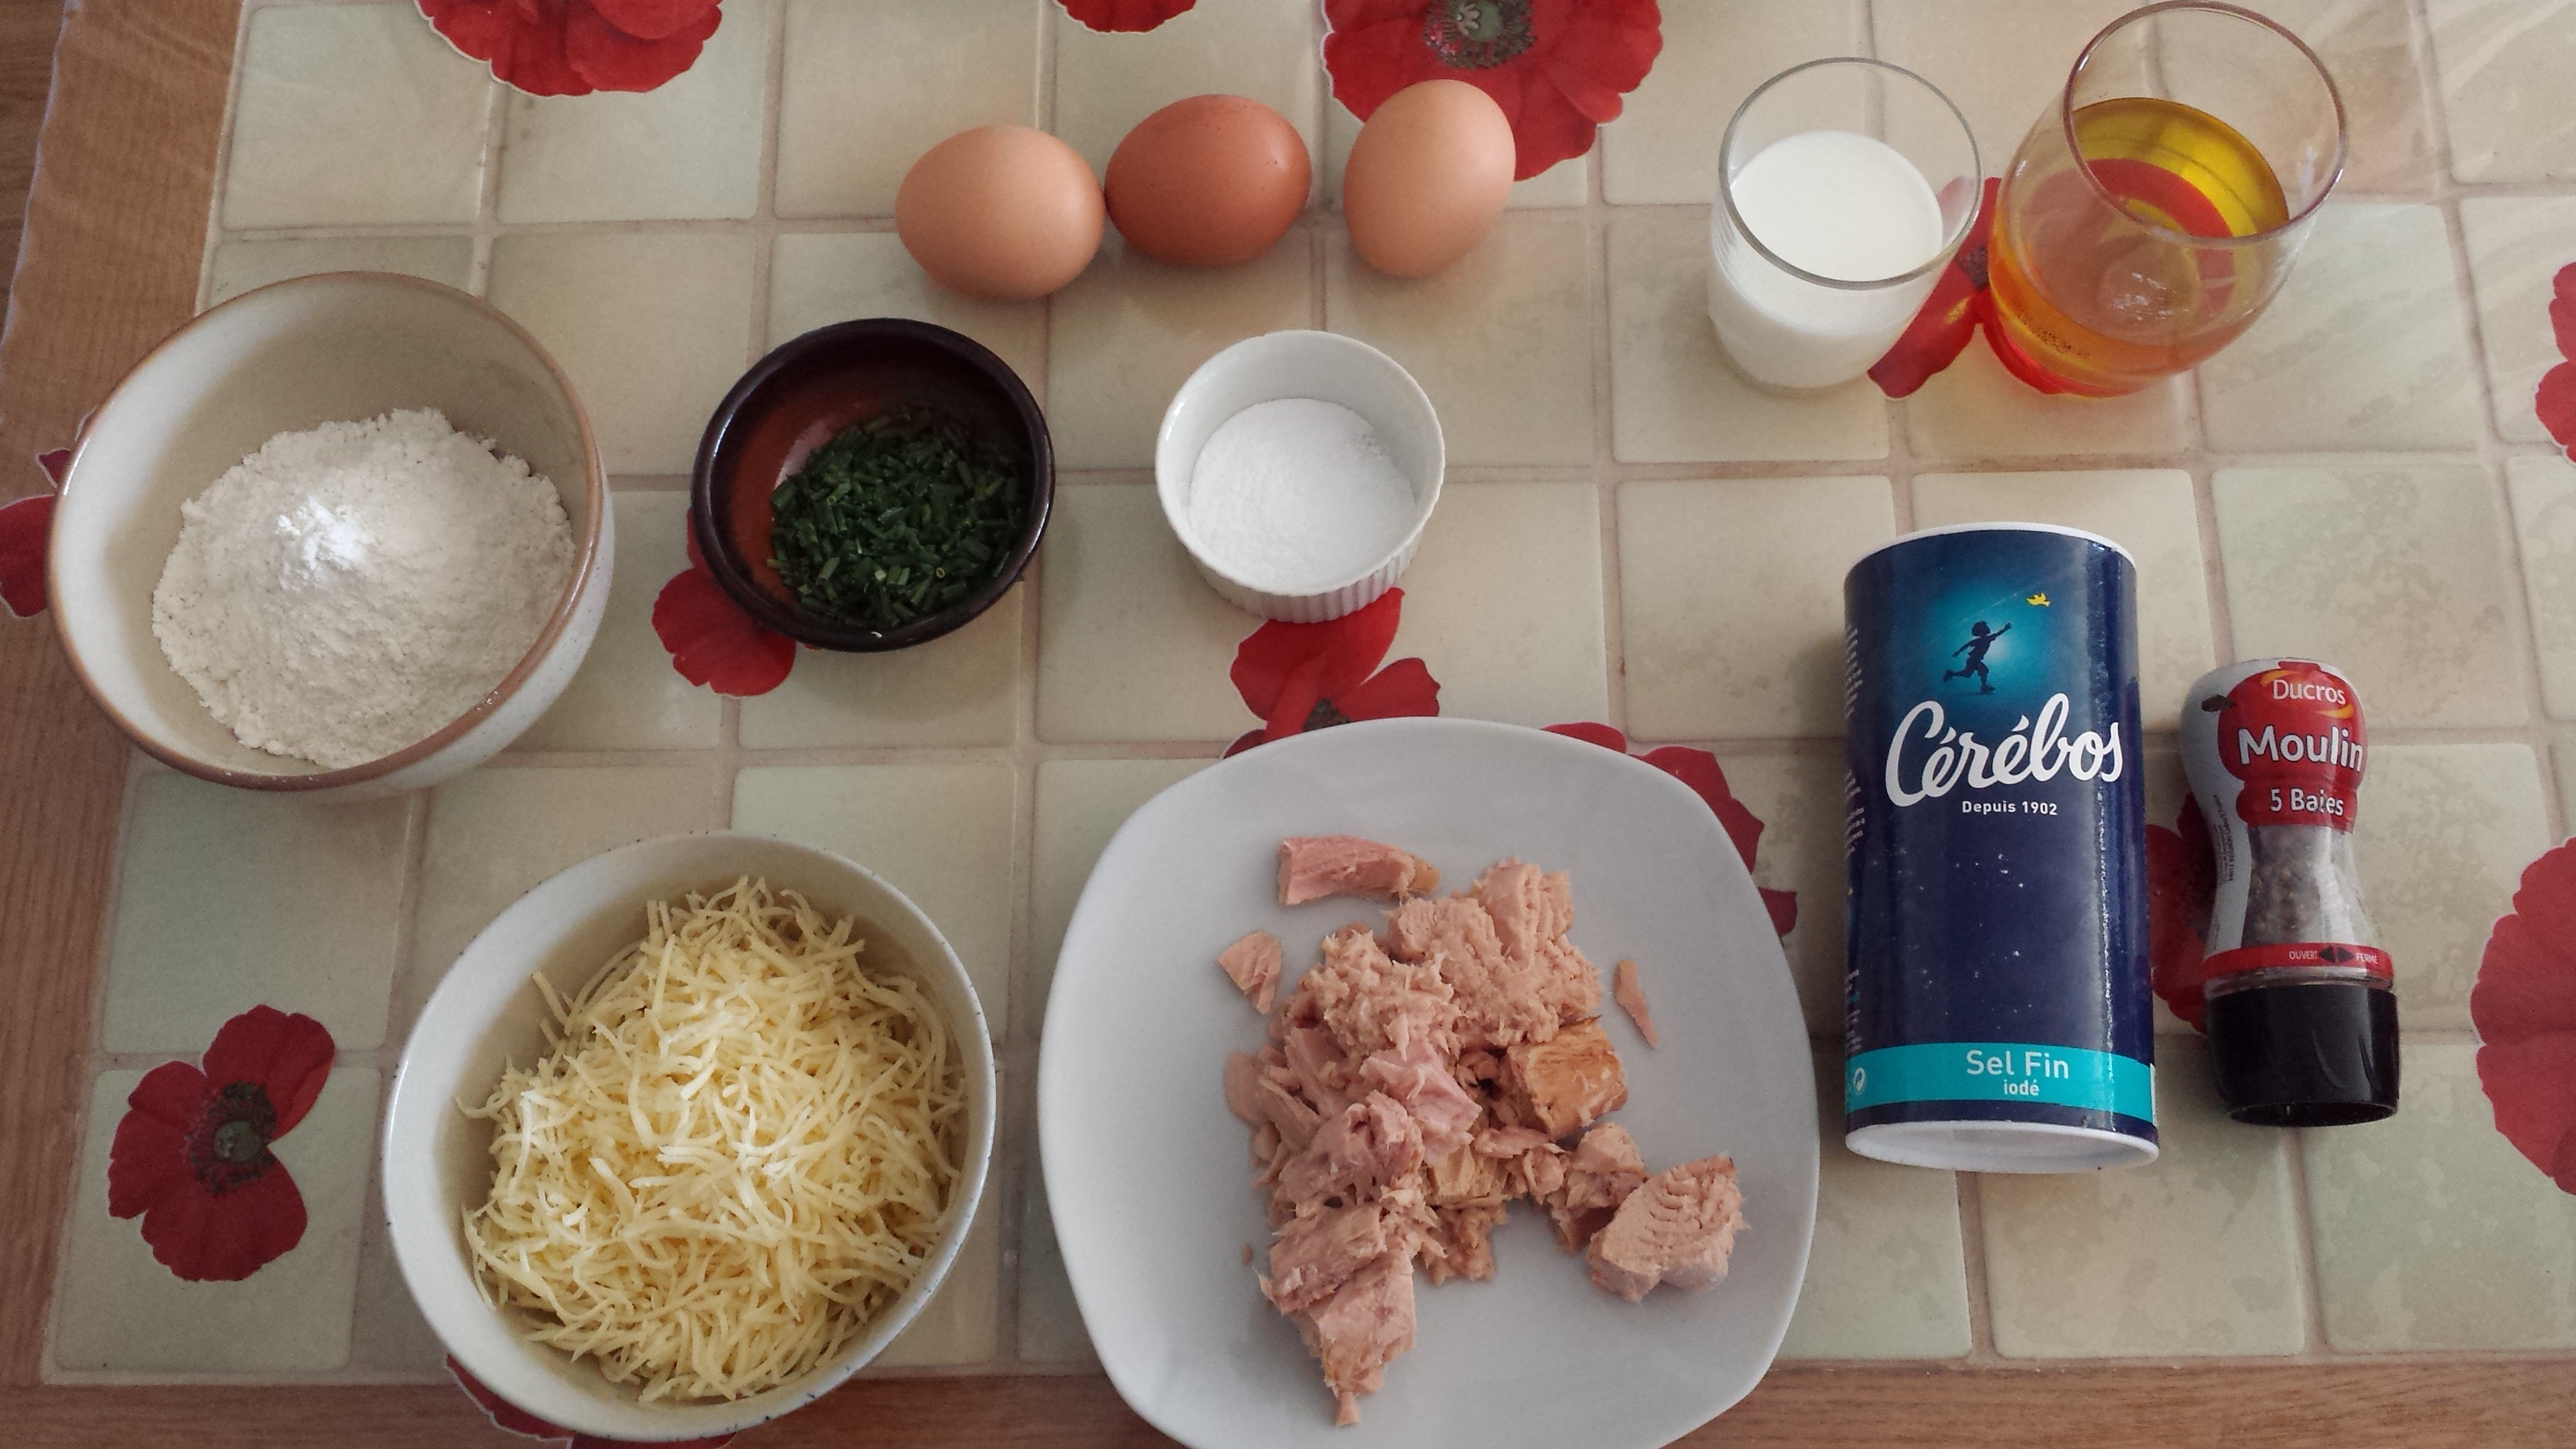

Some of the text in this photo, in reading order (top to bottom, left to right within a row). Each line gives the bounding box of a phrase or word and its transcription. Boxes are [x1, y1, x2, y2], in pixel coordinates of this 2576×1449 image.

[2272, 679, 2346, 706] Ducros
[1885, 692, 2124, 807] Cérébos
[2237, 724, 2364, 773] Moulin
[1961, 800, 2058, 816] Depuis 1902
[2270, 788, 2345, 817] 5 Baies
[2289, 950, 2318, 960] OUVERT
[1965, 1050, 2069, 1080] Sel Fin
[2003, 1078, 2040, 1097] iodé
